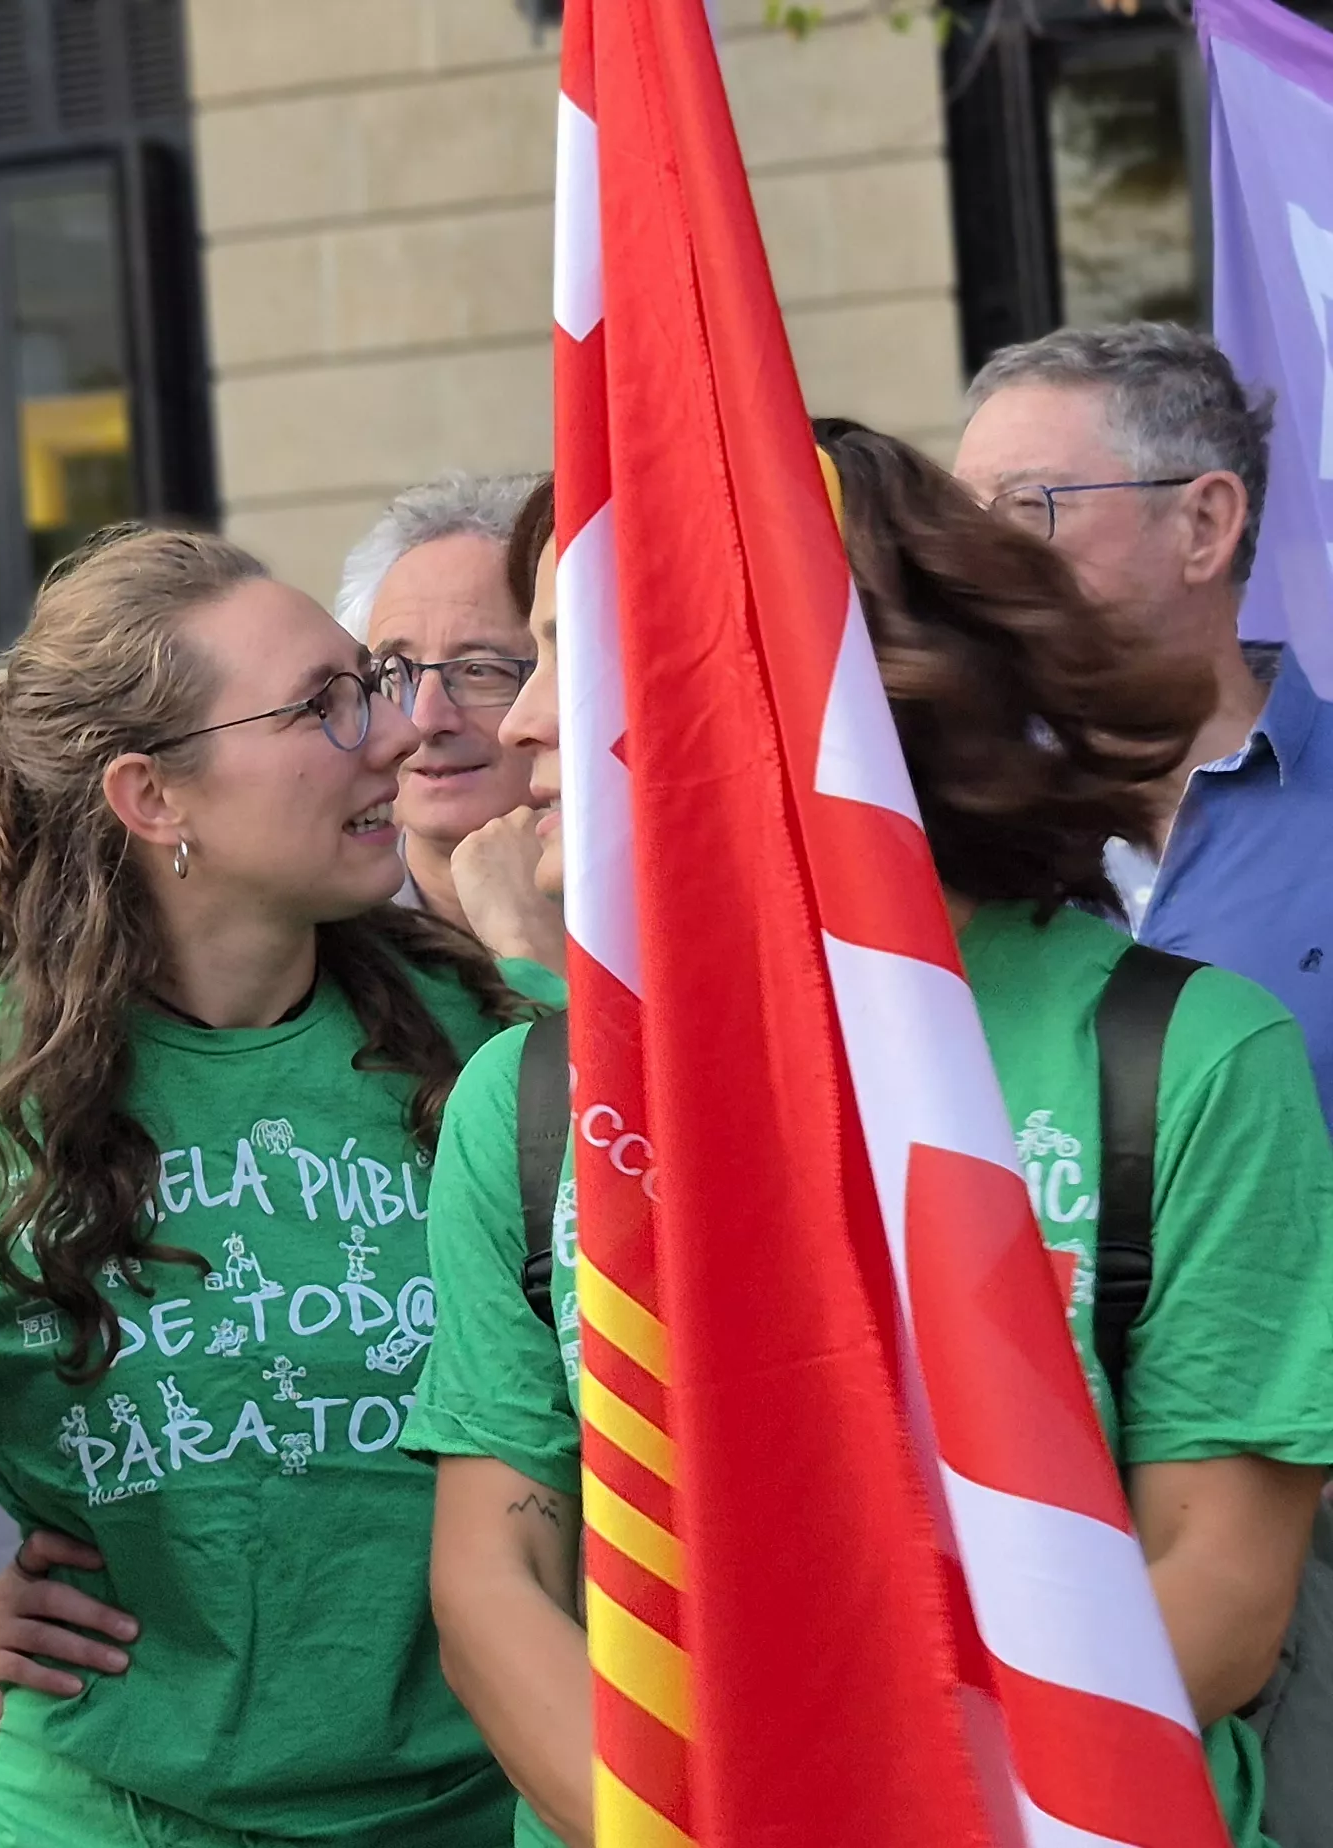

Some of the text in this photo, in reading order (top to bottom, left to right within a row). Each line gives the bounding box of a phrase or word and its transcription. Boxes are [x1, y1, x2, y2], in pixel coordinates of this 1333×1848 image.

[288, 1137, 429, 1228] PÚBL
[233, 1276, 437, 1342] TOD@
[77, 1400, 278, 1488] PARA
[88, 1476, 159, 1507] Huesca
